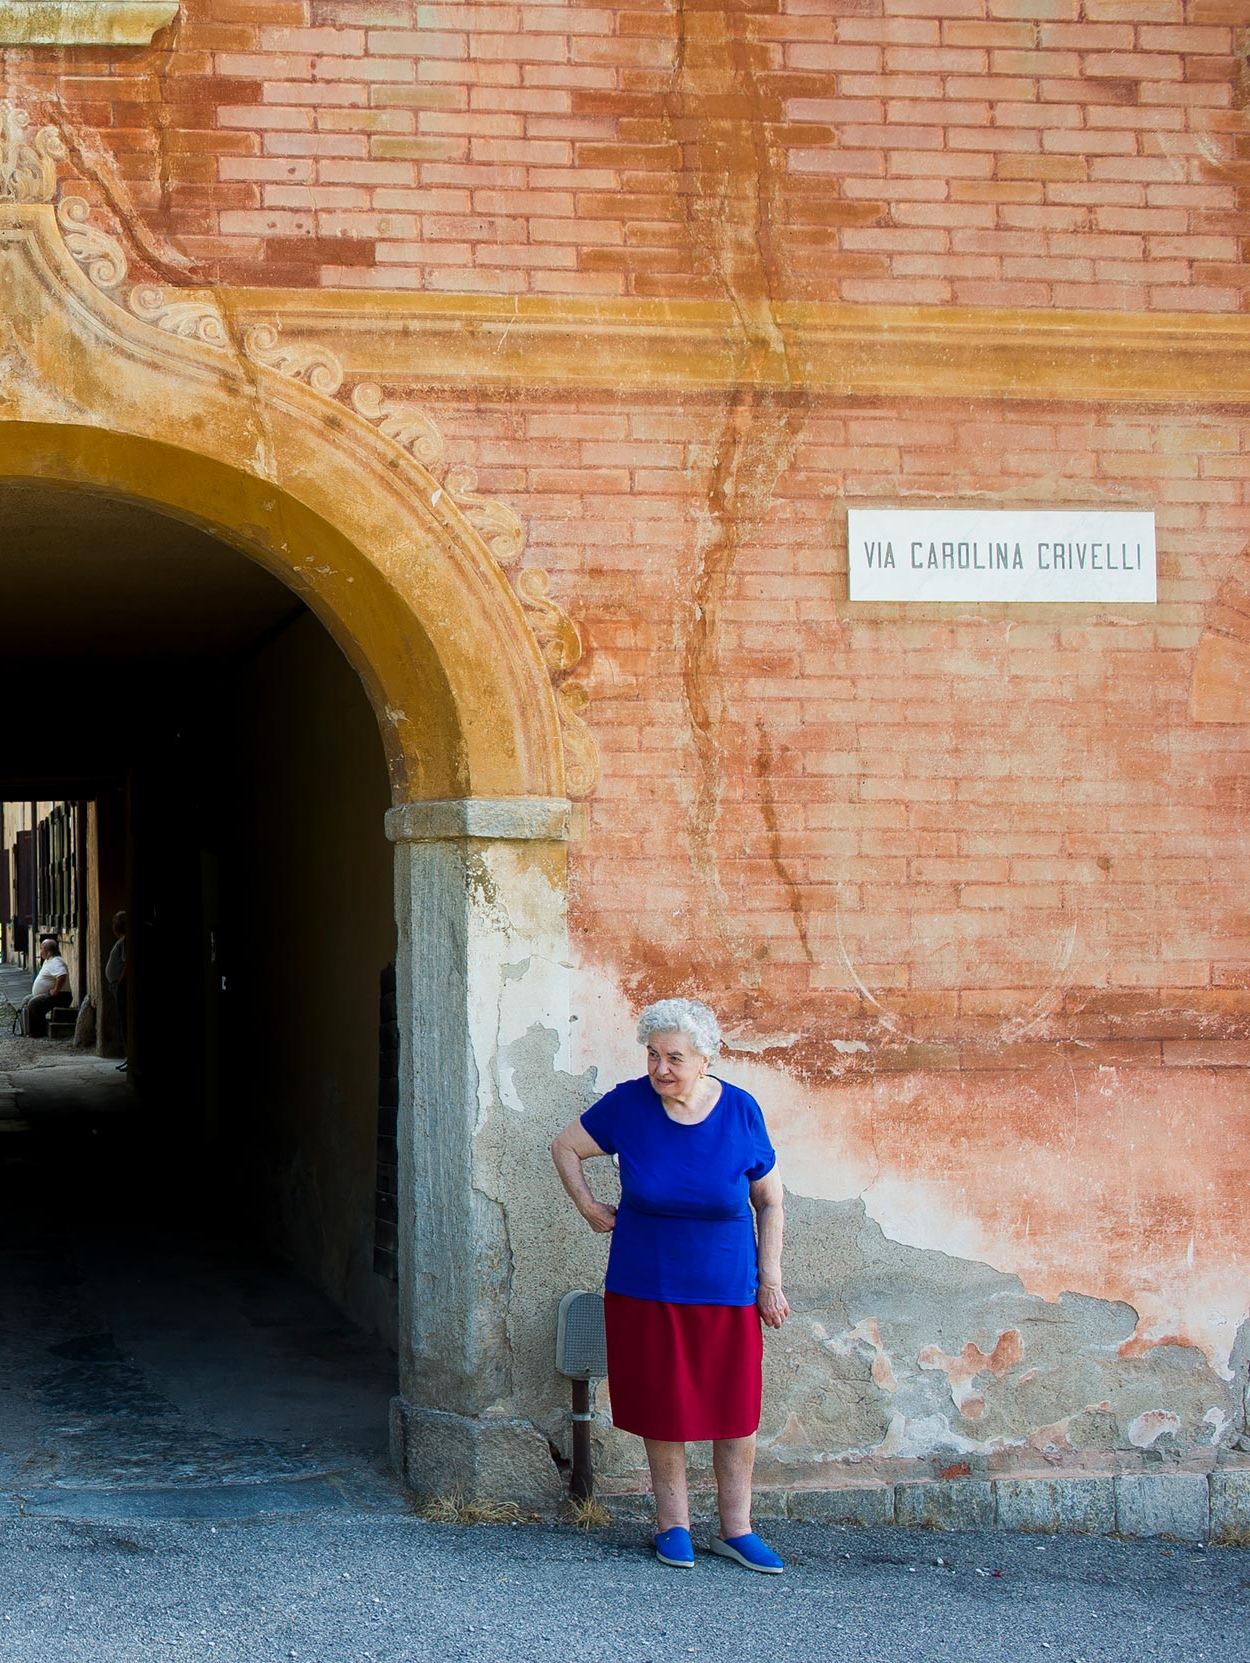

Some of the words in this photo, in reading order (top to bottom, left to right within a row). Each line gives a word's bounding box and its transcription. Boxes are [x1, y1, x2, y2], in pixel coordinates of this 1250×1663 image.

[863, 541, 896, 569] VIA
[911, 542, 1024, 570] CAROLINA
[1038, 542, 1141, 570] CRIVELLI
